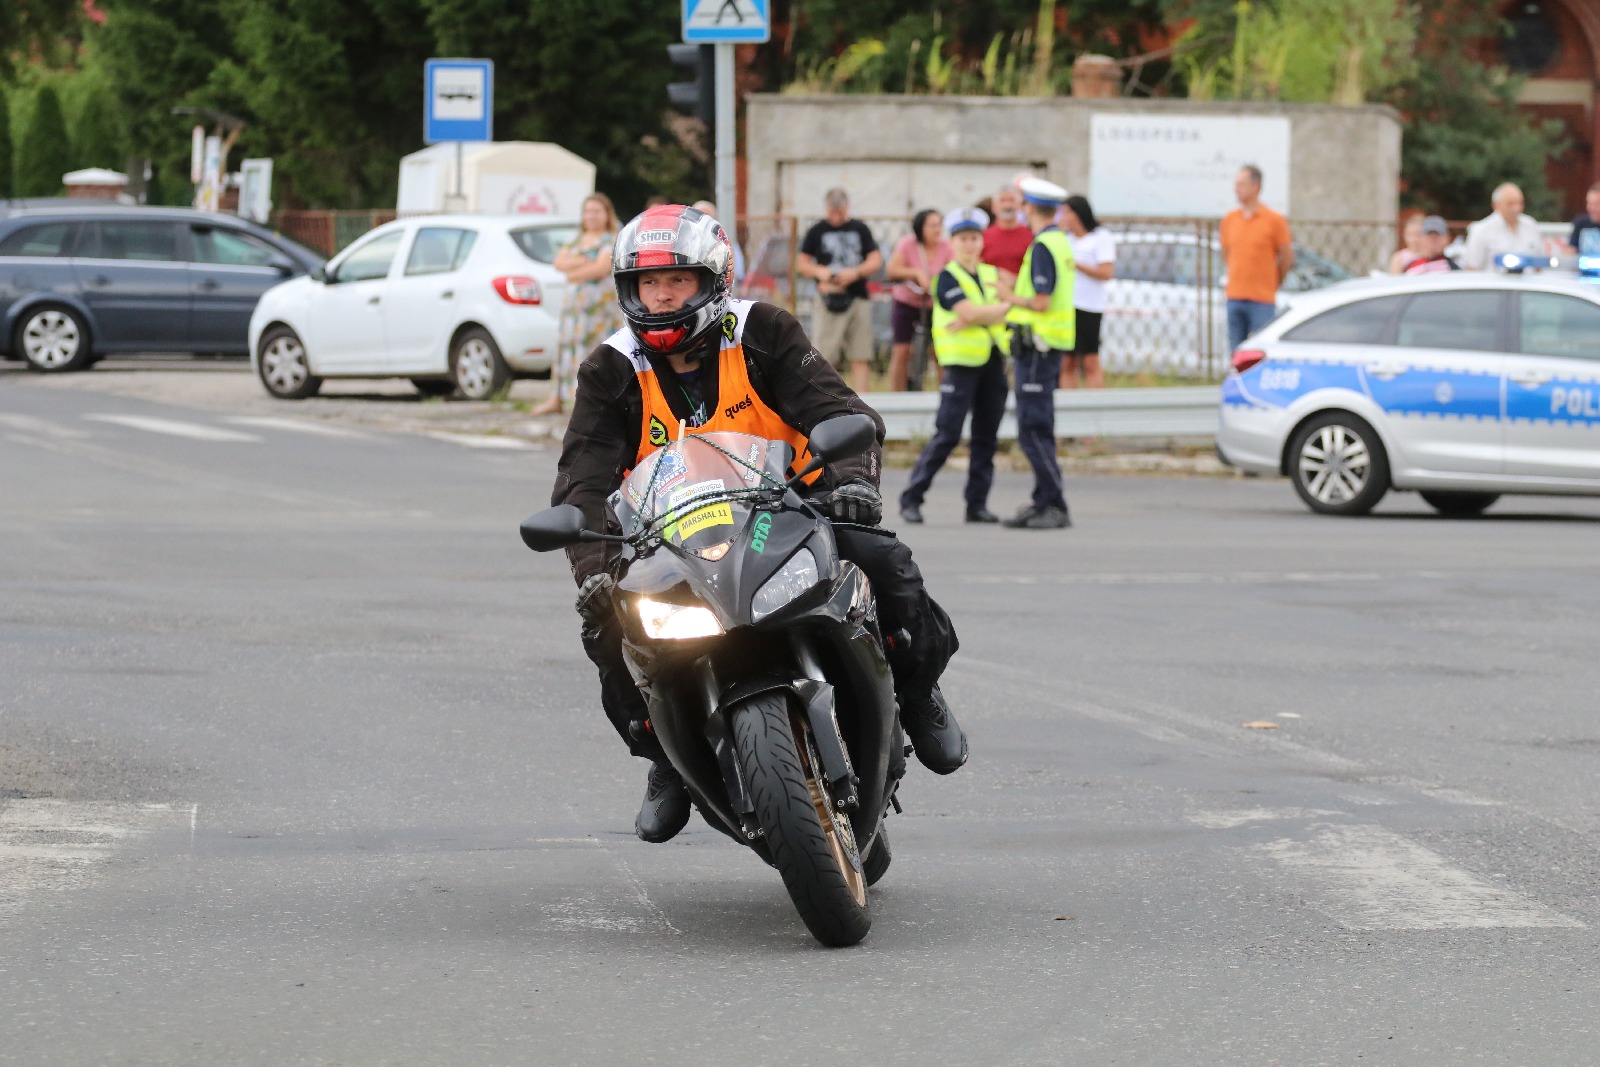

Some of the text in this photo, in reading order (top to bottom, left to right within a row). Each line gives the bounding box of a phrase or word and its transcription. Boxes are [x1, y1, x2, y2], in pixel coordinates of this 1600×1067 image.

[640, 231, 672, 243] SHOEI
[1550, 387, 1600, 417] POL
[681, 509, 728, 531] MARSHAL 11
[750, 520, 772, 554] DTA
